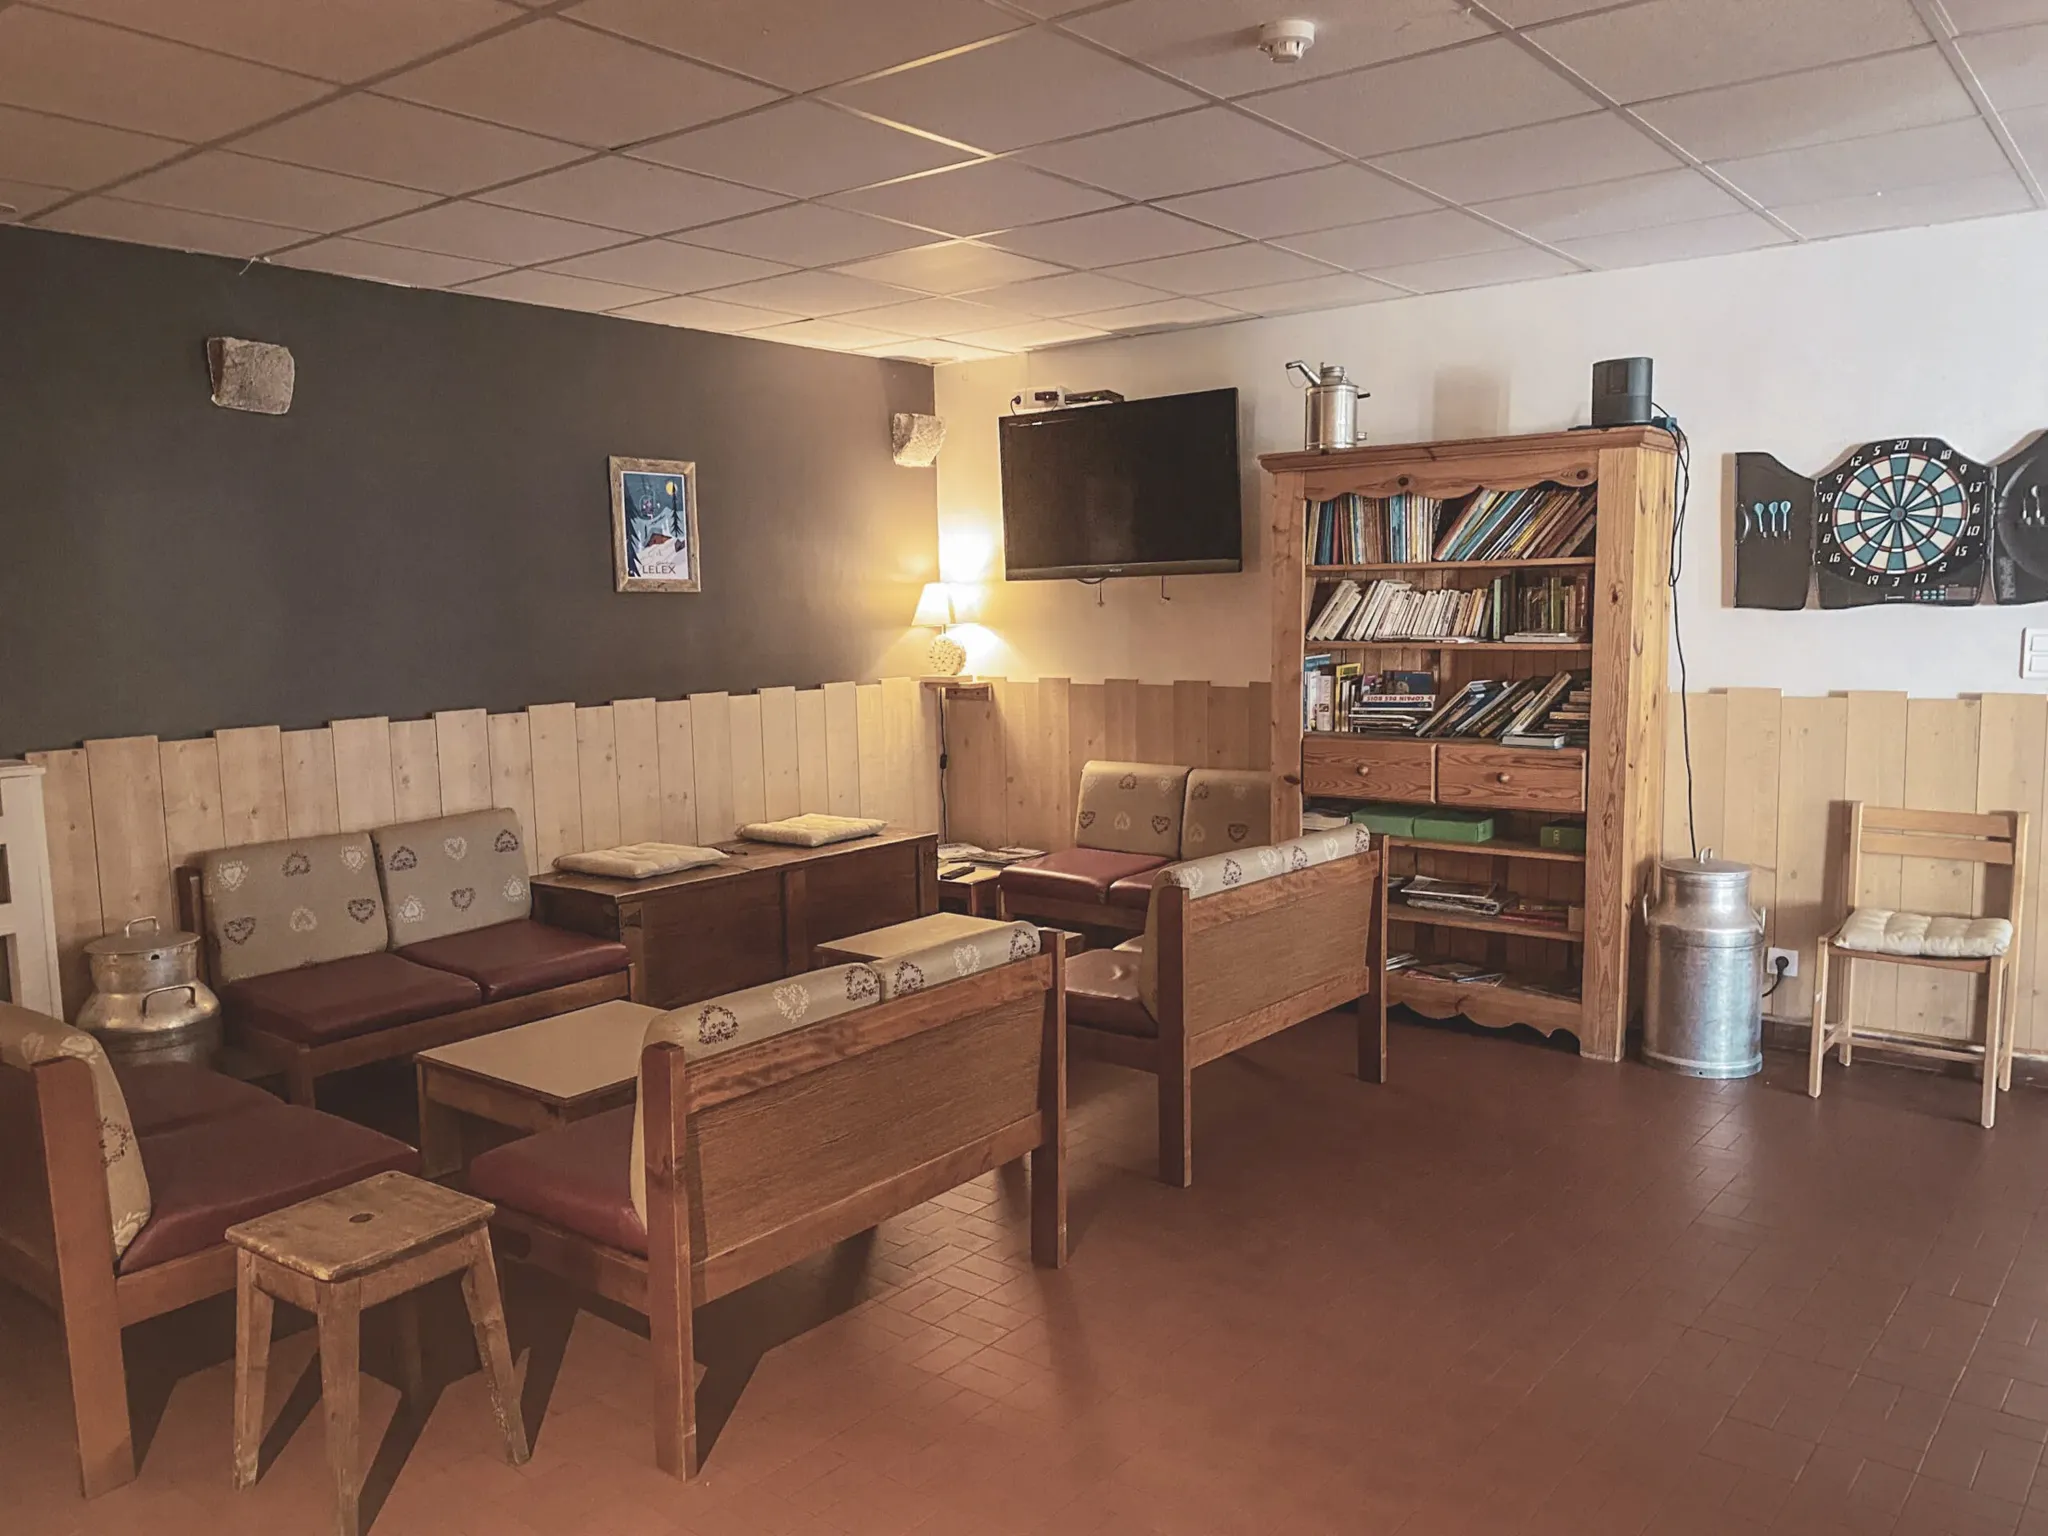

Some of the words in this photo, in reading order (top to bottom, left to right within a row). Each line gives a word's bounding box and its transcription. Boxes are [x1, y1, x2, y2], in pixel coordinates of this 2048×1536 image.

[1894, 439, 1910, 450] 20
[1873, 445, 1881, 456] 5
[1940, 449, 1953, 460] 18
[1850, 456, 1863, 467] 12
[1969, 482, 1981, 493] 13
[1972, 503, 1980, 514] 6
[1818, 512, 1829, 523] 11
[1966, 525, 1981, 536] 10
[1823, 533, 1831, 544] 8
[1955, 546, 1968, 557] 15
[1829, 552, 1841, 563] 16
[642, 565, 675, 574] LELEX
[1849, 566, 1856, 576] 7
[1938, 562, 1947, 572] 2
[1867, 574, 1880, 585] 19
[1892, 576, 1900, 587] 3
[1914, 573, 1927, 584] 17
